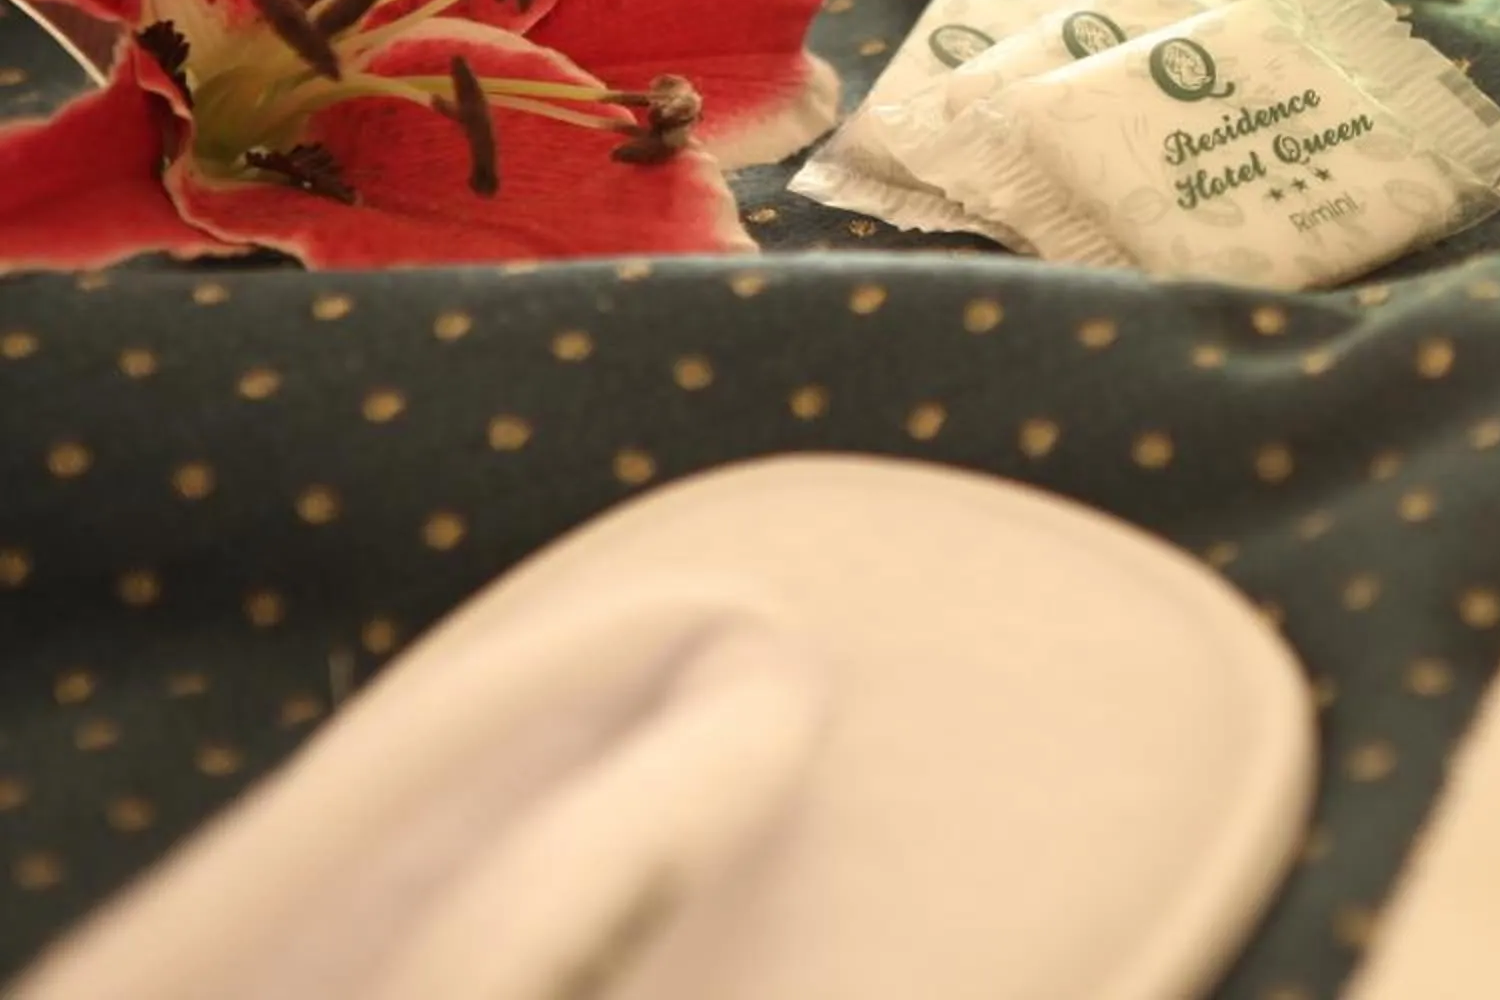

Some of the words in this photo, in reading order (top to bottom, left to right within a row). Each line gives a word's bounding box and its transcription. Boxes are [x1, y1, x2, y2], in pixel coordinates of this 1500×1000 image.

[1149, 38, 1235, 102] Q
[1164, 89, 1321, 166] Residence
[1174, 151, 1267, 210] Hotel
[1273, 114, 1374, 165] Queen
[1289, 192, 1360, 232] Rimini
